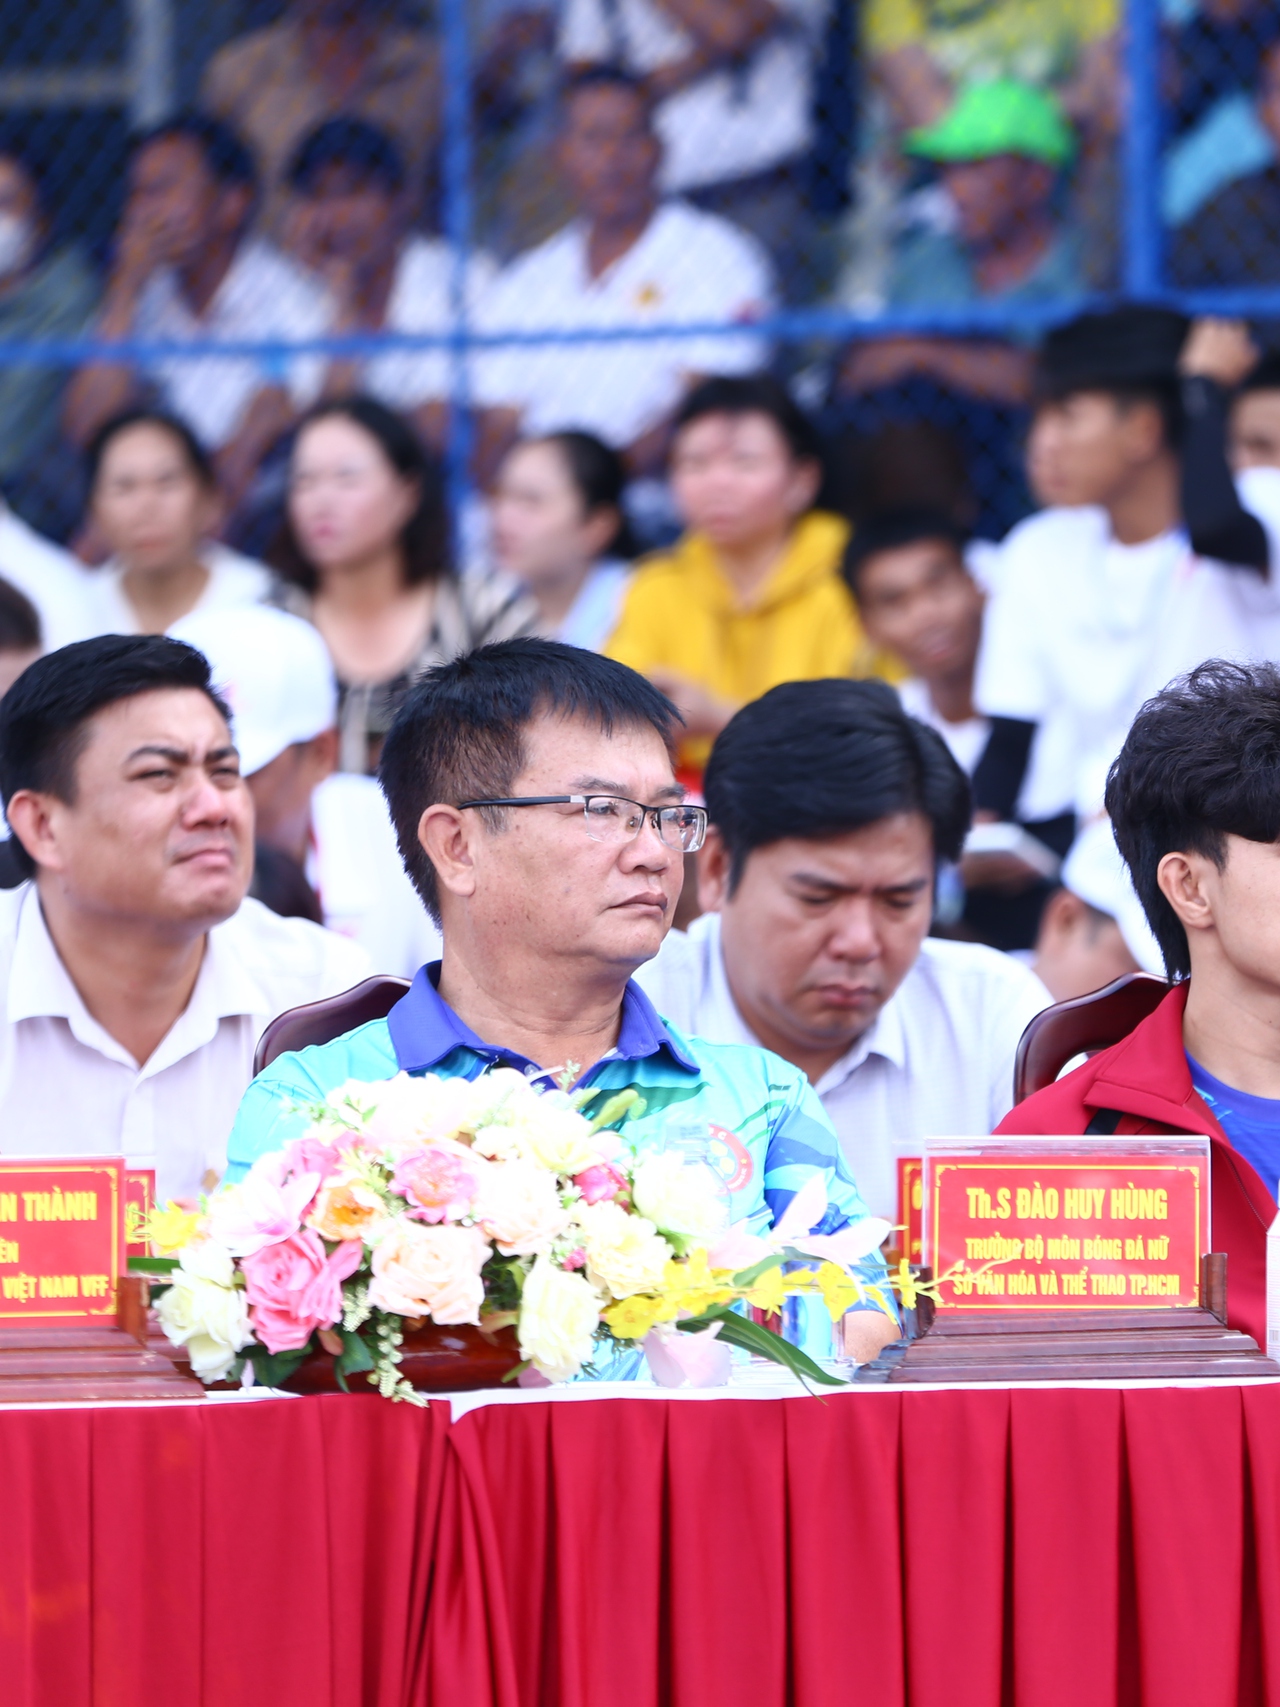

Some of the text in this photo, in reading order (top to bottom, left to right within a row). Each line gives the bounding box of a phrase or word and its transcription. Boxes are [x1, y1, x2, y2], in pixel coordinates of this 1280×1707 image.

[22, 1186, 97, 1221] THÀNH
[966, 1182, 1167, 1219] Th.S ĐÀO HUY HÙNG
[965, 1232, 1169, 1265] TRƯỞNG BỘ MÔN BÓNG ĐÁ NỮ
[2, 1272, 108, 1303] VIỆT NAM VFF
[953, 1267, 973, 1295] SỞ
[1008, 1270, 1037, 1295] HÓA
[1040, 1270, 1058, 1295] VÀ
[1061, 1266, 1088, 1295] THỂ
[1090, 1274, 1126, 1295] THAO
[1129, 1274, 1180, 1296] TP.HCM
